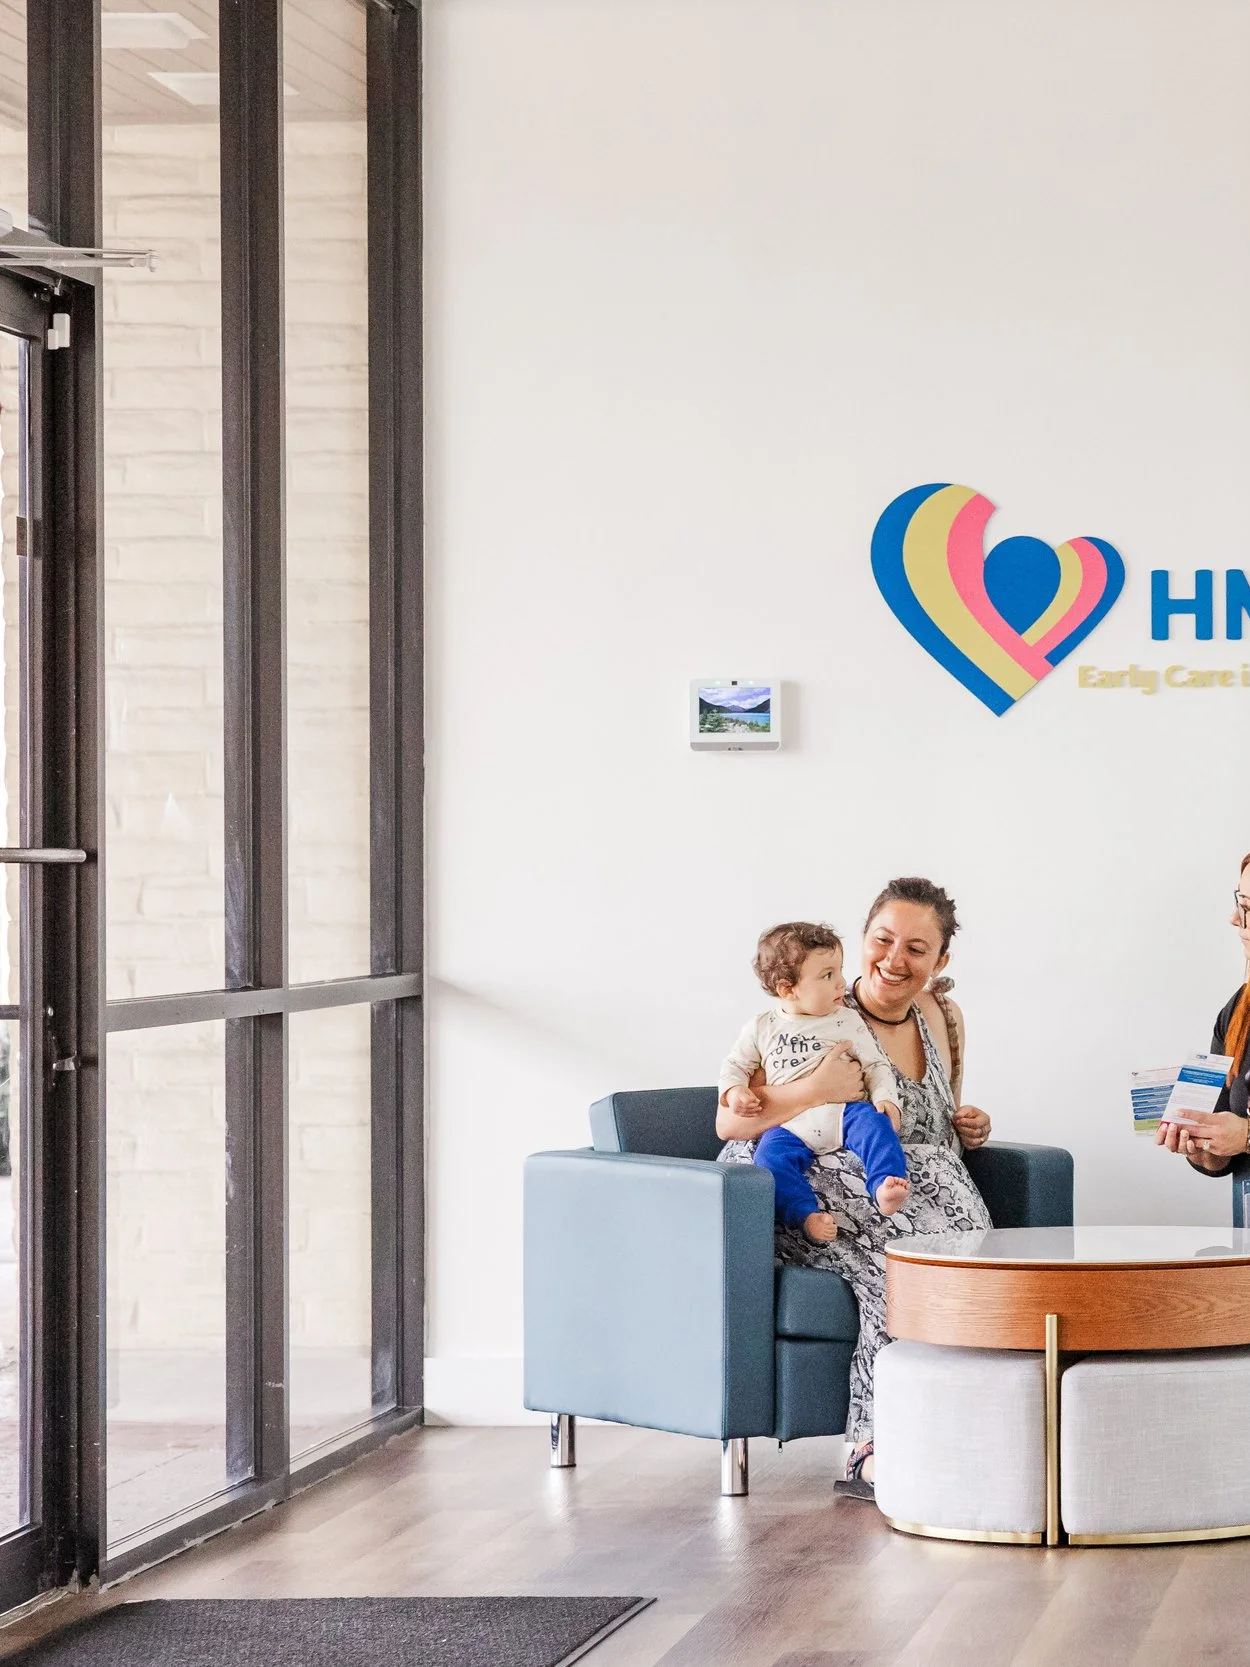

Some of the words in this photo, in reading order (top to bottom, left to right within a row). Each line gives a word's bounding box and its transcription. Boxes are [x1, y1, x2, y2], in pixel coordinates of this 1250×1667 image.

[1078, 664, 1160, 695] Early
[1164, 664, 1234, 688] Care
[790, 1040, 821, 1053] the
[773, 1057, 807, 1069] cre
